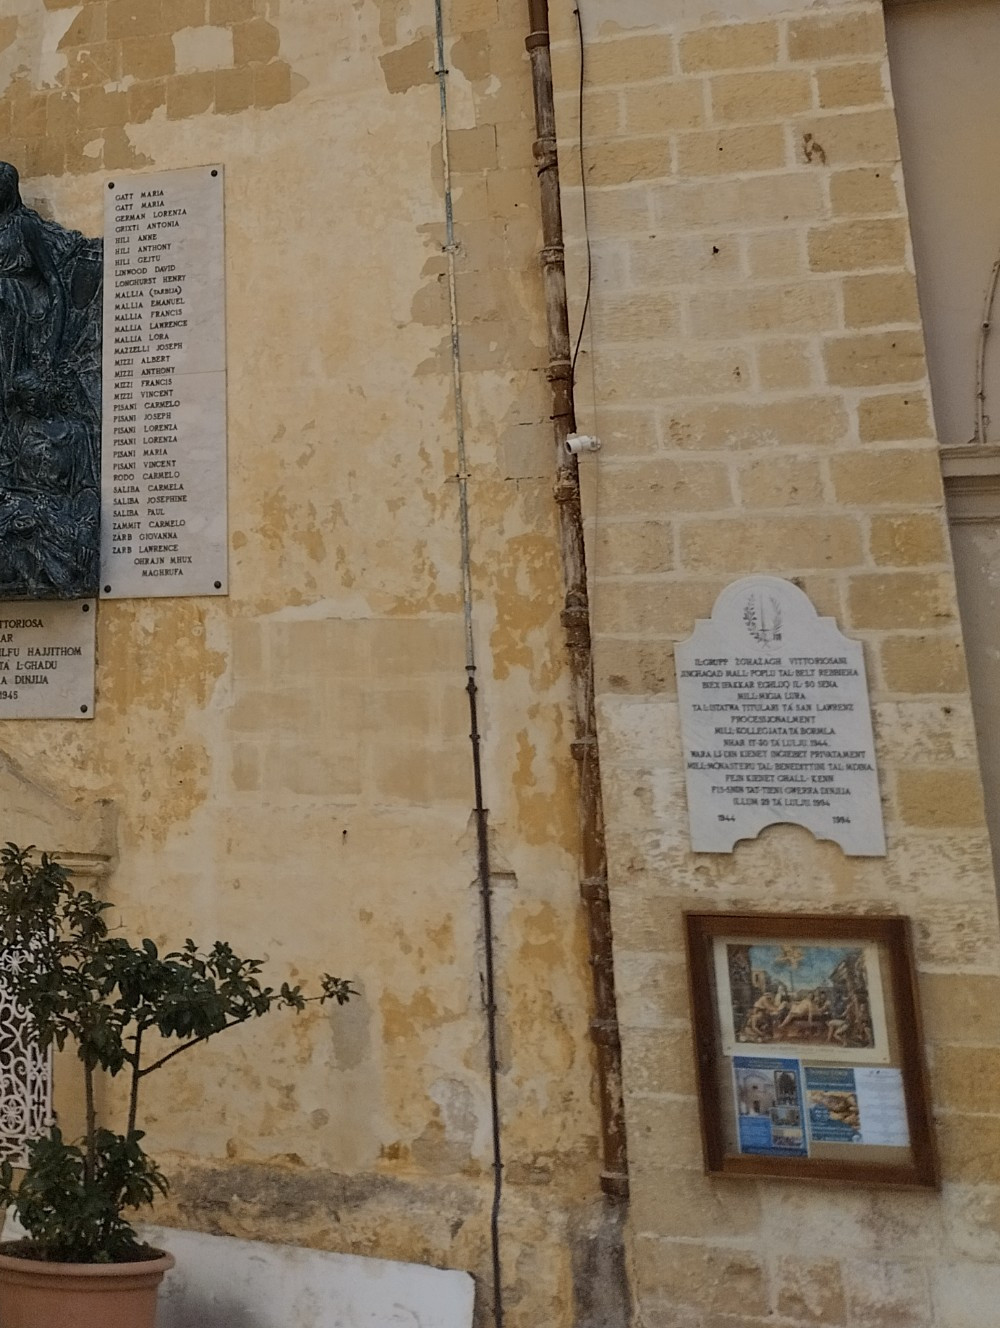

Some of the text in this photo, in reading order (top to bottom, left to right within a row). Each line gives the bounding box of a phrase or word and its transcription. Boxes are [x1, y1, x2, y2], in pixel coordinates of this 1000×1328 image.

[115, 190, 164, 201] GATT MARIA
[115, 200, 164, 211] GATT MARIA
[115, 209, 186, 222] GERMAN LORENZA
[115, 220, 179, 232] GRIXTI ANTONIA
[115, 236, 129, 244] HILI
[115, 243, 171, 255] HILI ANTHONY
[115, 258, 129, 266] HILI
[154, 264, 175, 272] DAVID
[115, 277, 156, 287] LONGHURST
[114, 290, 144, 299] MALLIA
[114, 298, 185, 310] MALLIA EMANUEL
[114, 309, 182, 321] MALLIA FRANCIS
[114, 320, 187, 332] MALLIA LAWRENCE
[114, 335, 142, 343] MALLIA
[156, 342, 182, 350] JOSEPH
[114, 355, 170, 366] MIZZI ALBERT
[140, 367, 175, 375] ANTHONY
[141, 378, 172, 386] FRANCIS
[113, 389, 173, 400] MIZZI VINCENT
[113, 400, 180, 411] PISANI CARMELO
[144, 412, 171, 420] JOSEPH
[144, 424, 177, 432] LORENZA
[113, 435, 177, 446] PISANI LORENZA
[113, 450, 135, 458] PISANI
[113, 460, 176, 470] PISANI VINCENT
[142, 471, 180, 479] CARMELO
[147, 483, 184, 491] CARMELA
[113, 495, 187, 505] SALIBA JOSEPHINE
[113, 509, 139, 517] SALIBA
[138, 532, 177, 540] GIOVANNA
[17, 660, 57, 670] L-GHADU
[0, 691, 18, 699] 1945
